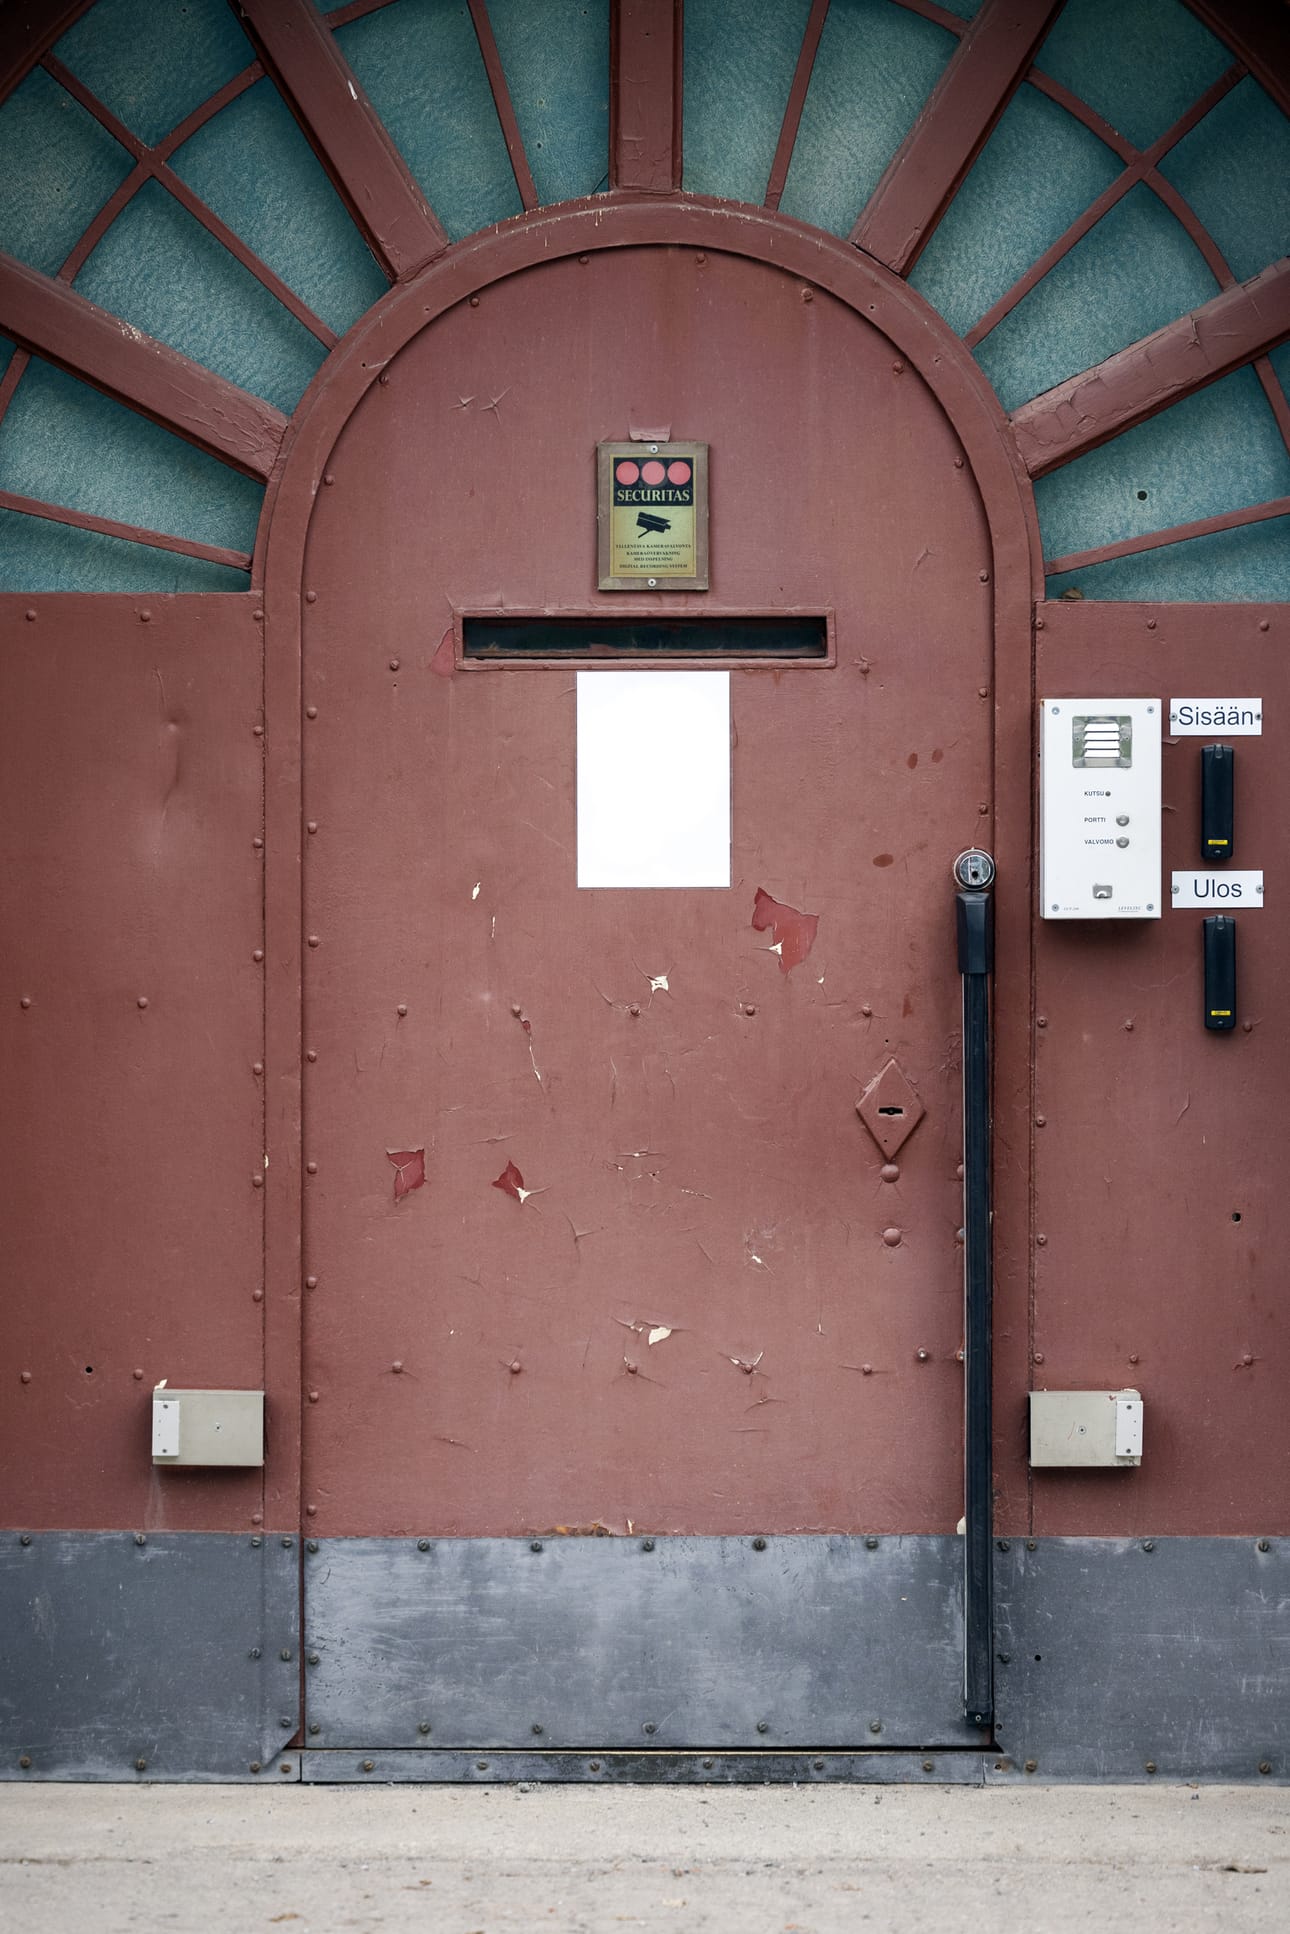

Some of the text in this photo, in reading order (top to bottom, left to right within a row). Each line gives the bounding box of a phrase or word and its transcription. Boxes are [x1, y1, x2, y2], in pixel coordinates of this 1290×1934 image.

[617, 489, 690, 502] SECURITAS
[1178, 706, 1254, 726] Sisään
[1194, 879, 1243, 898] Ulos
